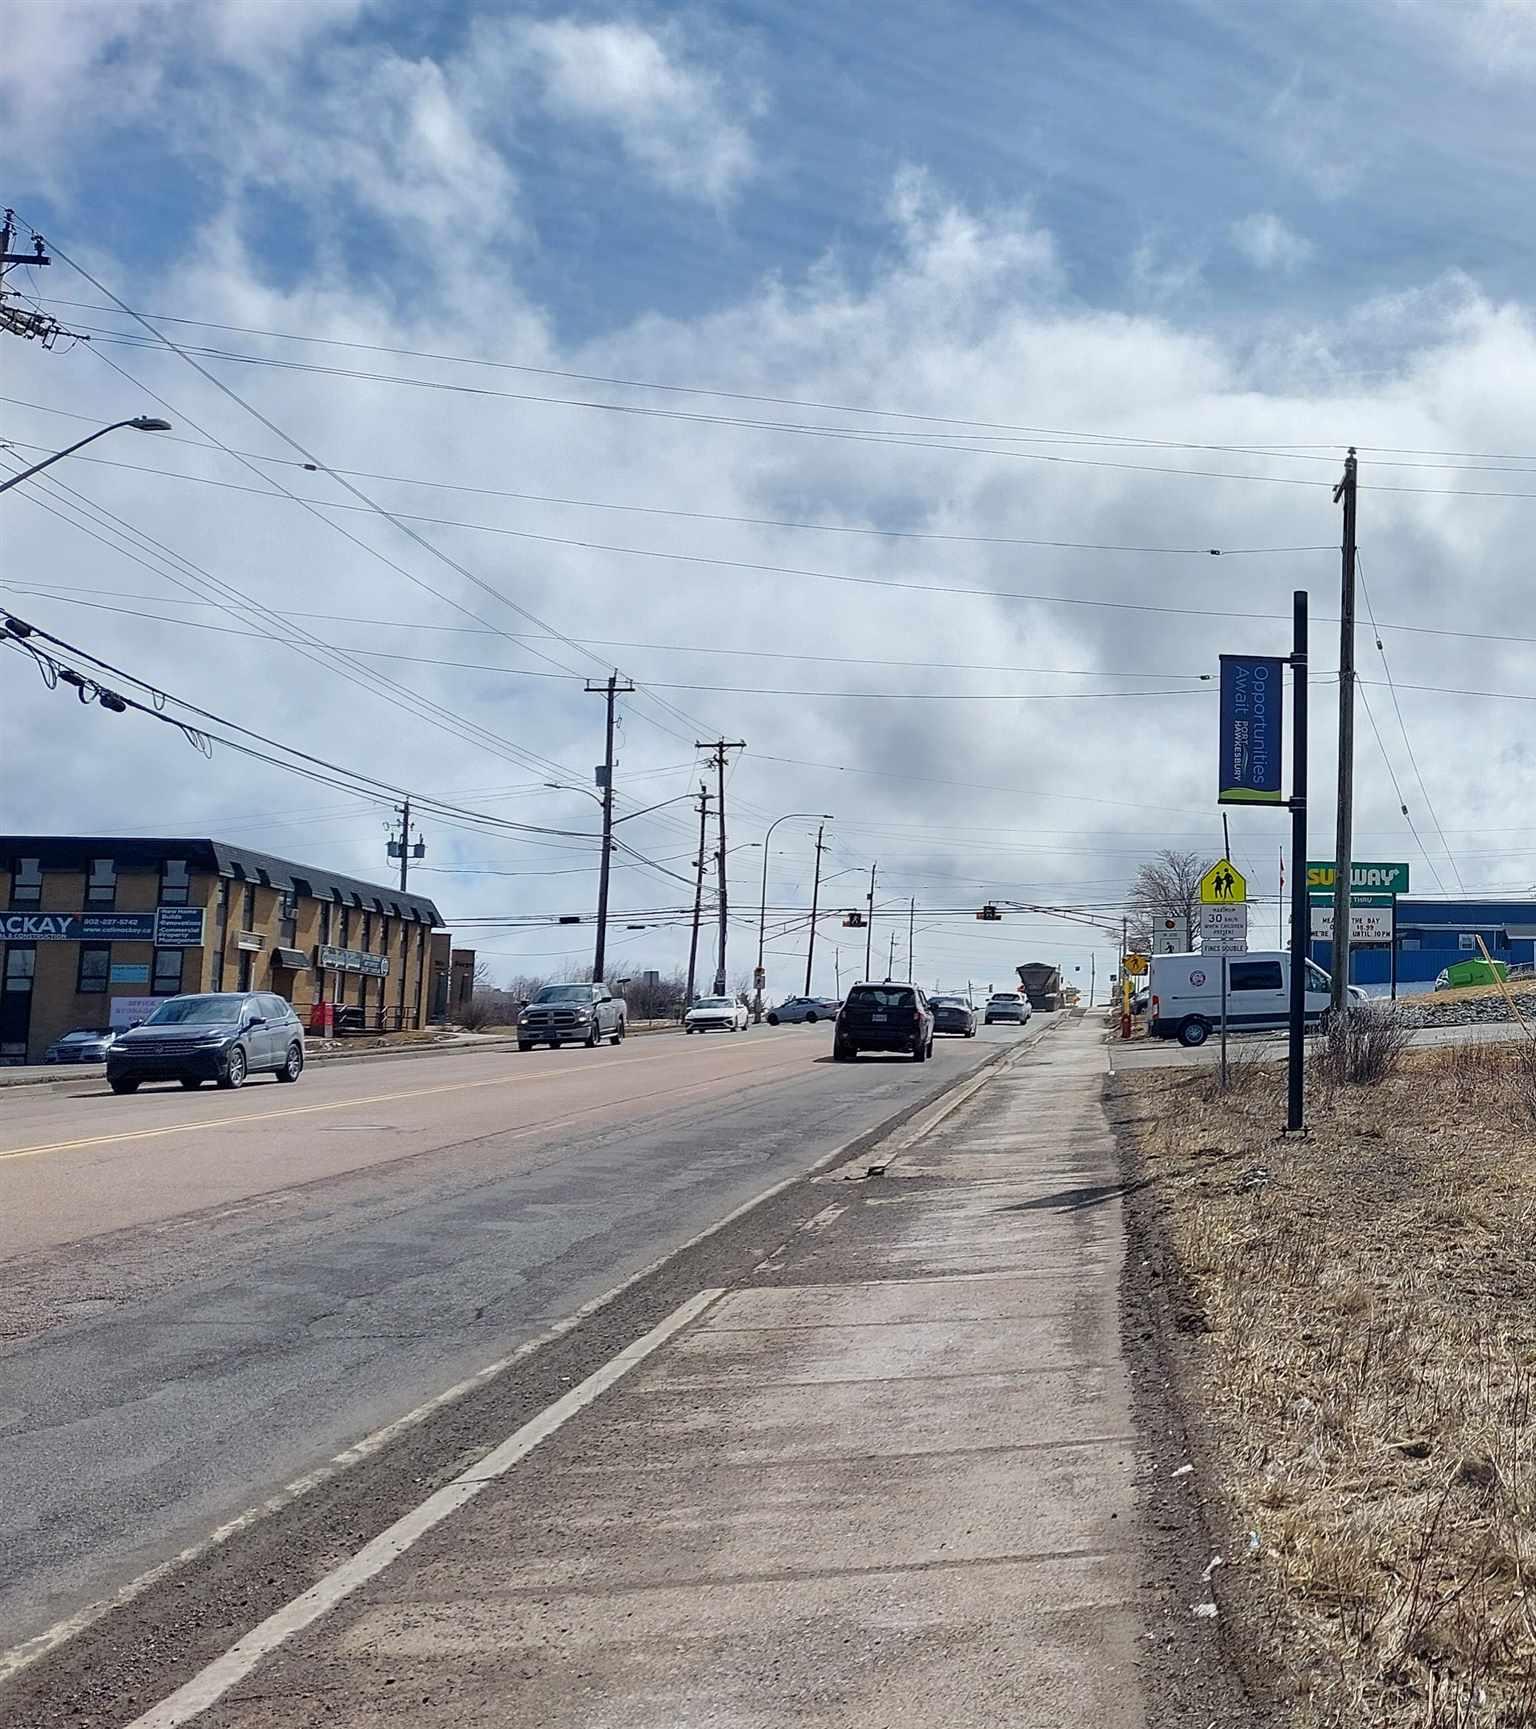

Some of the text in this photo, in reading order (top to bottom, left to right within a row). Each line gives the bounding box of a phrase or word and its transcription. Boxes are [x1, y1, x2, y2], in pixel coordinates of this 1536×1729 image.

[1234, 665, 1250, 715] Await
[1240, 720, 1249, 746] PORT
[1251, 666, 1270, 784] Opportunities
[1232, 719, 1242, 782] HAWKESBURY
[1307, 868, 1400, 886] SUWAY
[1208, 913, 1222, 923] 30
